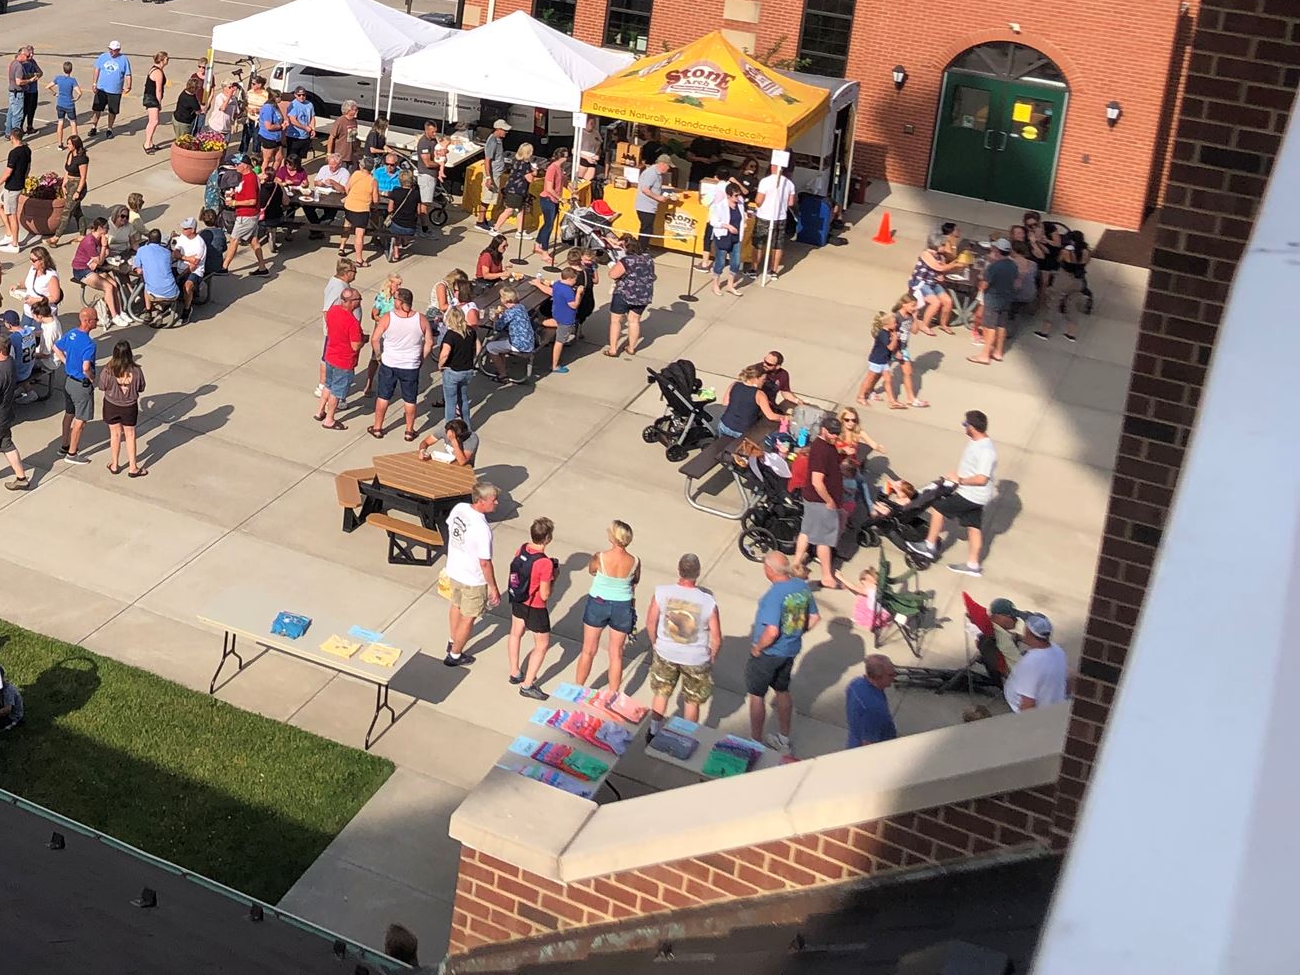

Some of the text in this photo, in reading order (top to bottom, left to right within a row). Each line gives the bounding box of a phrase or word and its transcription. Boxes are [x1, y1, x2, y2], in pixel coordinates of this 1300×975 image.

[684, 79, 710, 87] Arch
[674, 117, 732, 135] Handcrafted
[733, 128, 766, 141] Locally
